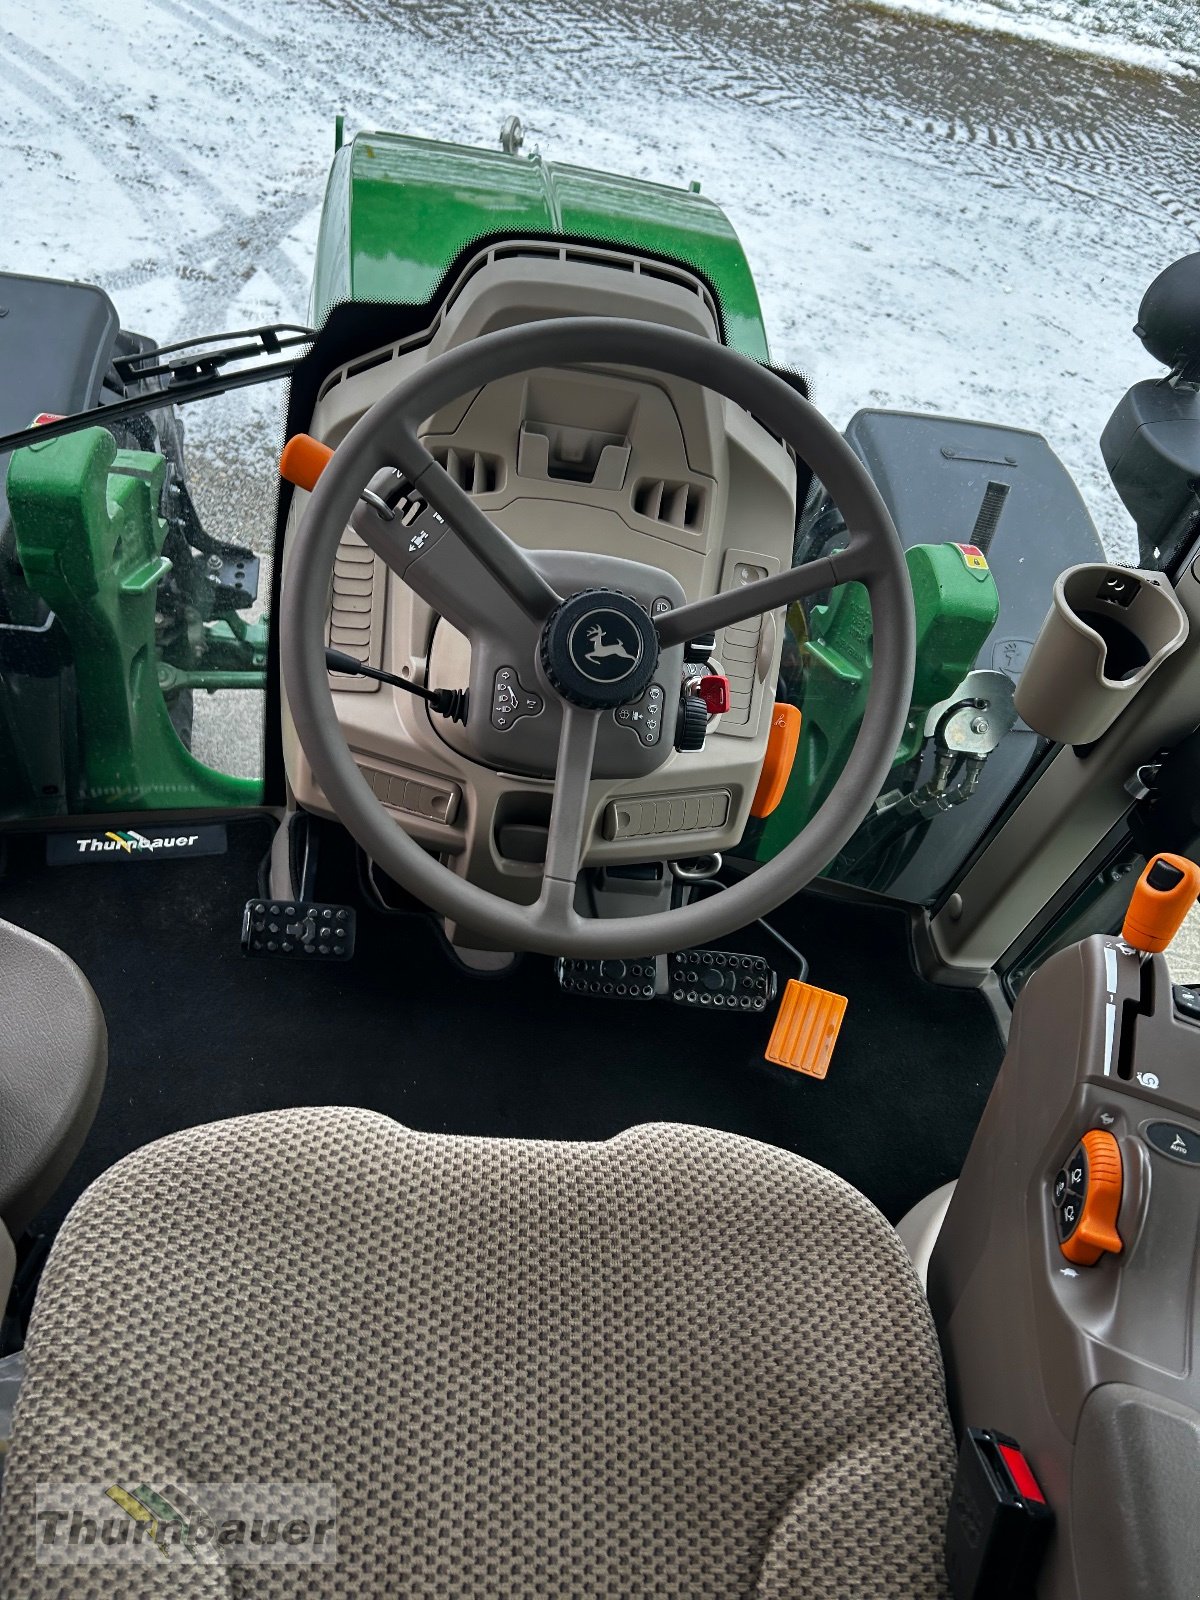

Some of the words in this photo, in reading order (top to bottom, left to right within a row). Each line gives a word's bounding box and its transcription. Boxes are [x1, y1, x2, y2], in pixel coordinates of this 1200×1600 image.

[1105, 941, 1112, 949] 2
[1109, 994, 1114, 1003] 1
[1170, 1144, 1188, 1154] AUTO
